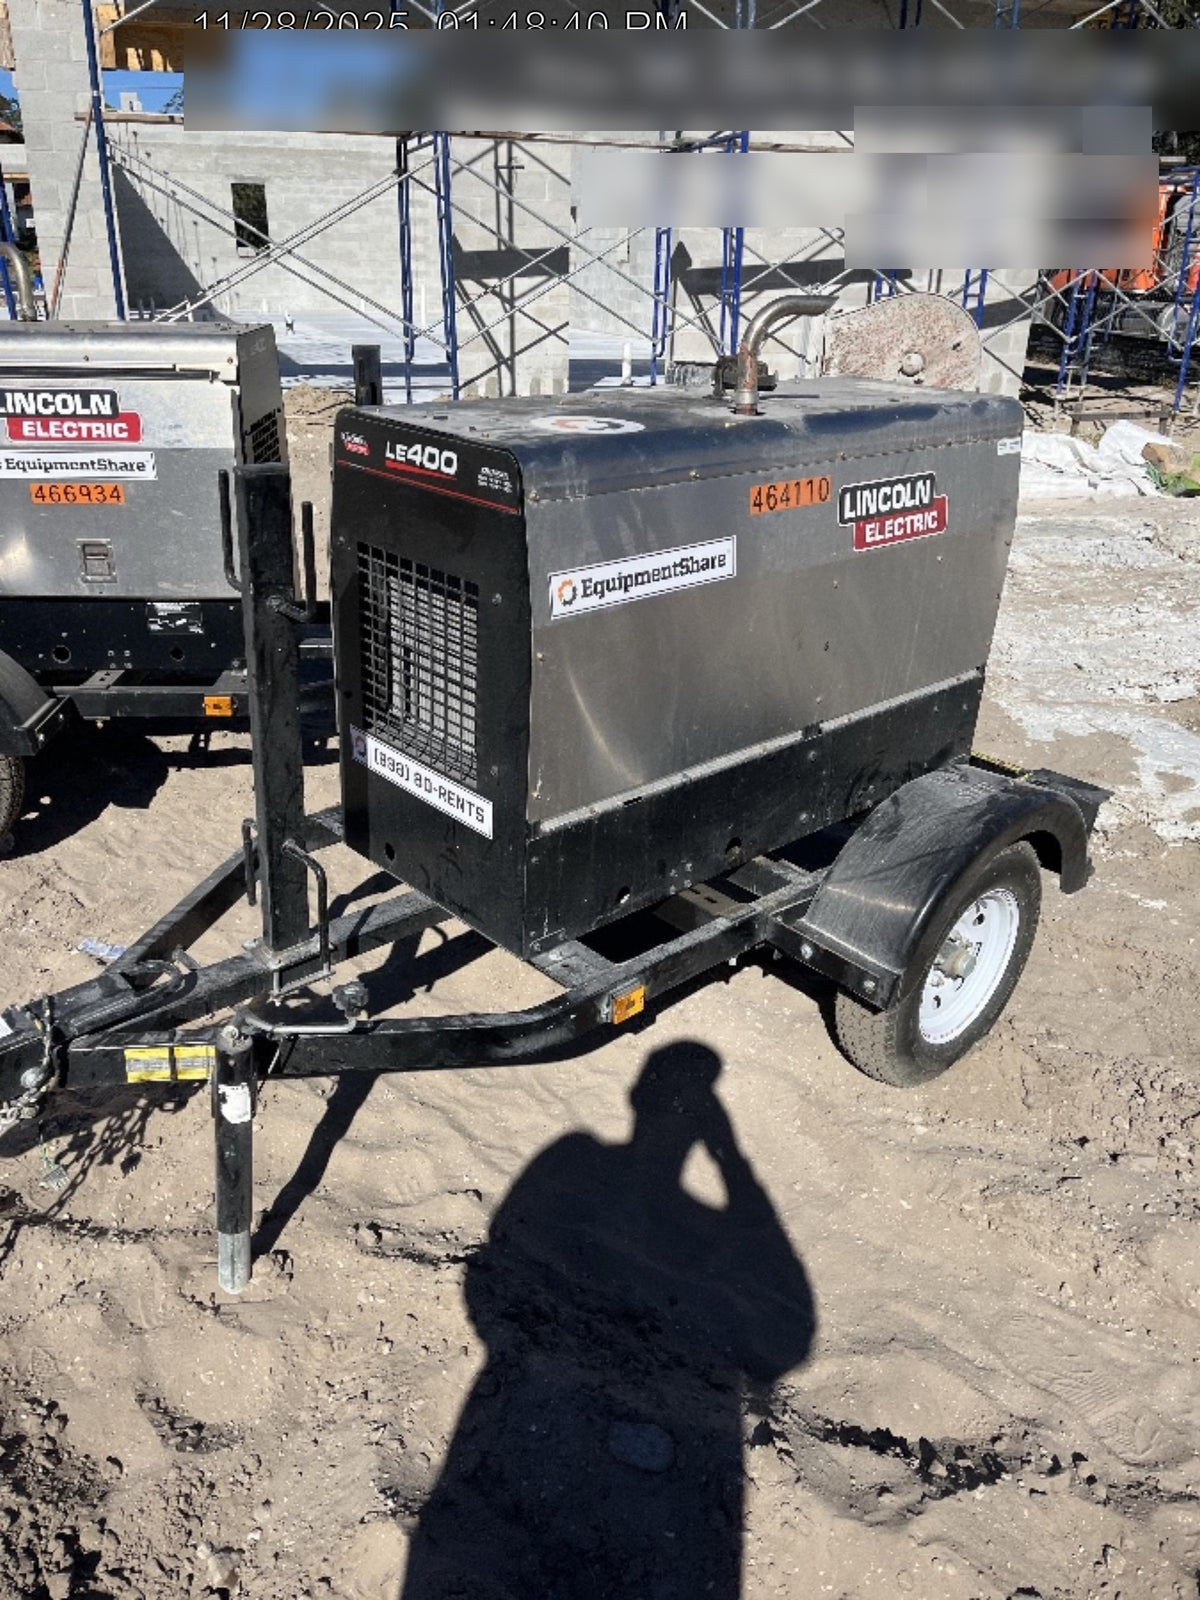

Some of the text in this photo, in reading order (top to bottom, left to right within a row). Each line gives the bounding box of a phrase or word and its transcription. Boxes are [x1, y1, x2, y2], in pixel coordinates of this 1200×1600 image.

[22, 421, 129, 438] ELECTRIC
[4, 458, 147, 474] EquipmentShare
[385, 440, 458, 475] LE400
[34, 484, 122, 503] 466934
[752, 477, 830, 513] 464110
[844, 479, 931, 519] LINCOLN
[865, 511, 938, 543] ELECTRIC
[580, 554, 726, 599] EquipmentShare
